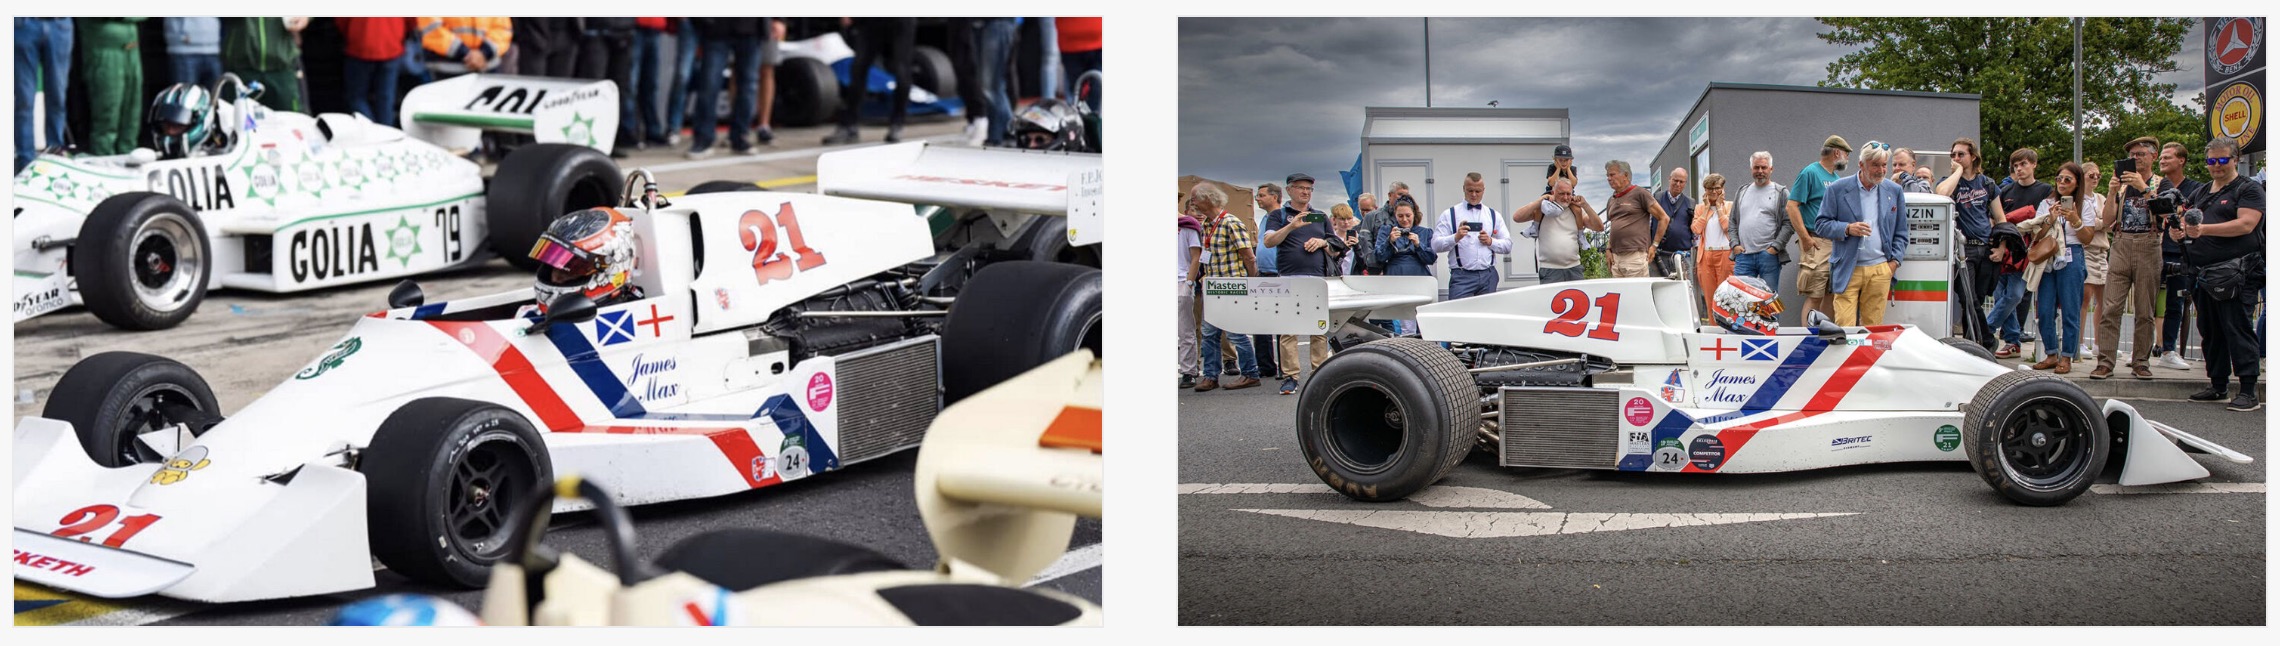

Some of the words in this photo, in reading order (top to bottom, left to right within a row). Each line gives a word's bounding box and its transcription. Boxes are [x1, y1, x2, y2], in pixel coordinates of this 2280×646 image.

[2215, 85, 2242, 112] MOTOR
[2243, 86, 2256, 104] OIL
[2224, 110, 2246, 122] SHELL
[435, 205, 462, 263] 79
[738, 201, 827, 286] 21
[291, 222, 379, 284] GOLIA
[1207, 281, 1247, 290] Masters
[1543, 288, 1621, 341] 21
[627, 352, 677, 388] James
[1704, 368, 1756, 389] James
[638, 376, 679, 403] Max
[1704, 386, 1749, 403] Max
[1841, 435, 1872, 445] BRITEC
[785, 453, 800, 470] 24
[1662, 452, 1679, 465] 24
[50, 504, 163, 548] 21
[14, 548, 96, 577] KETH
